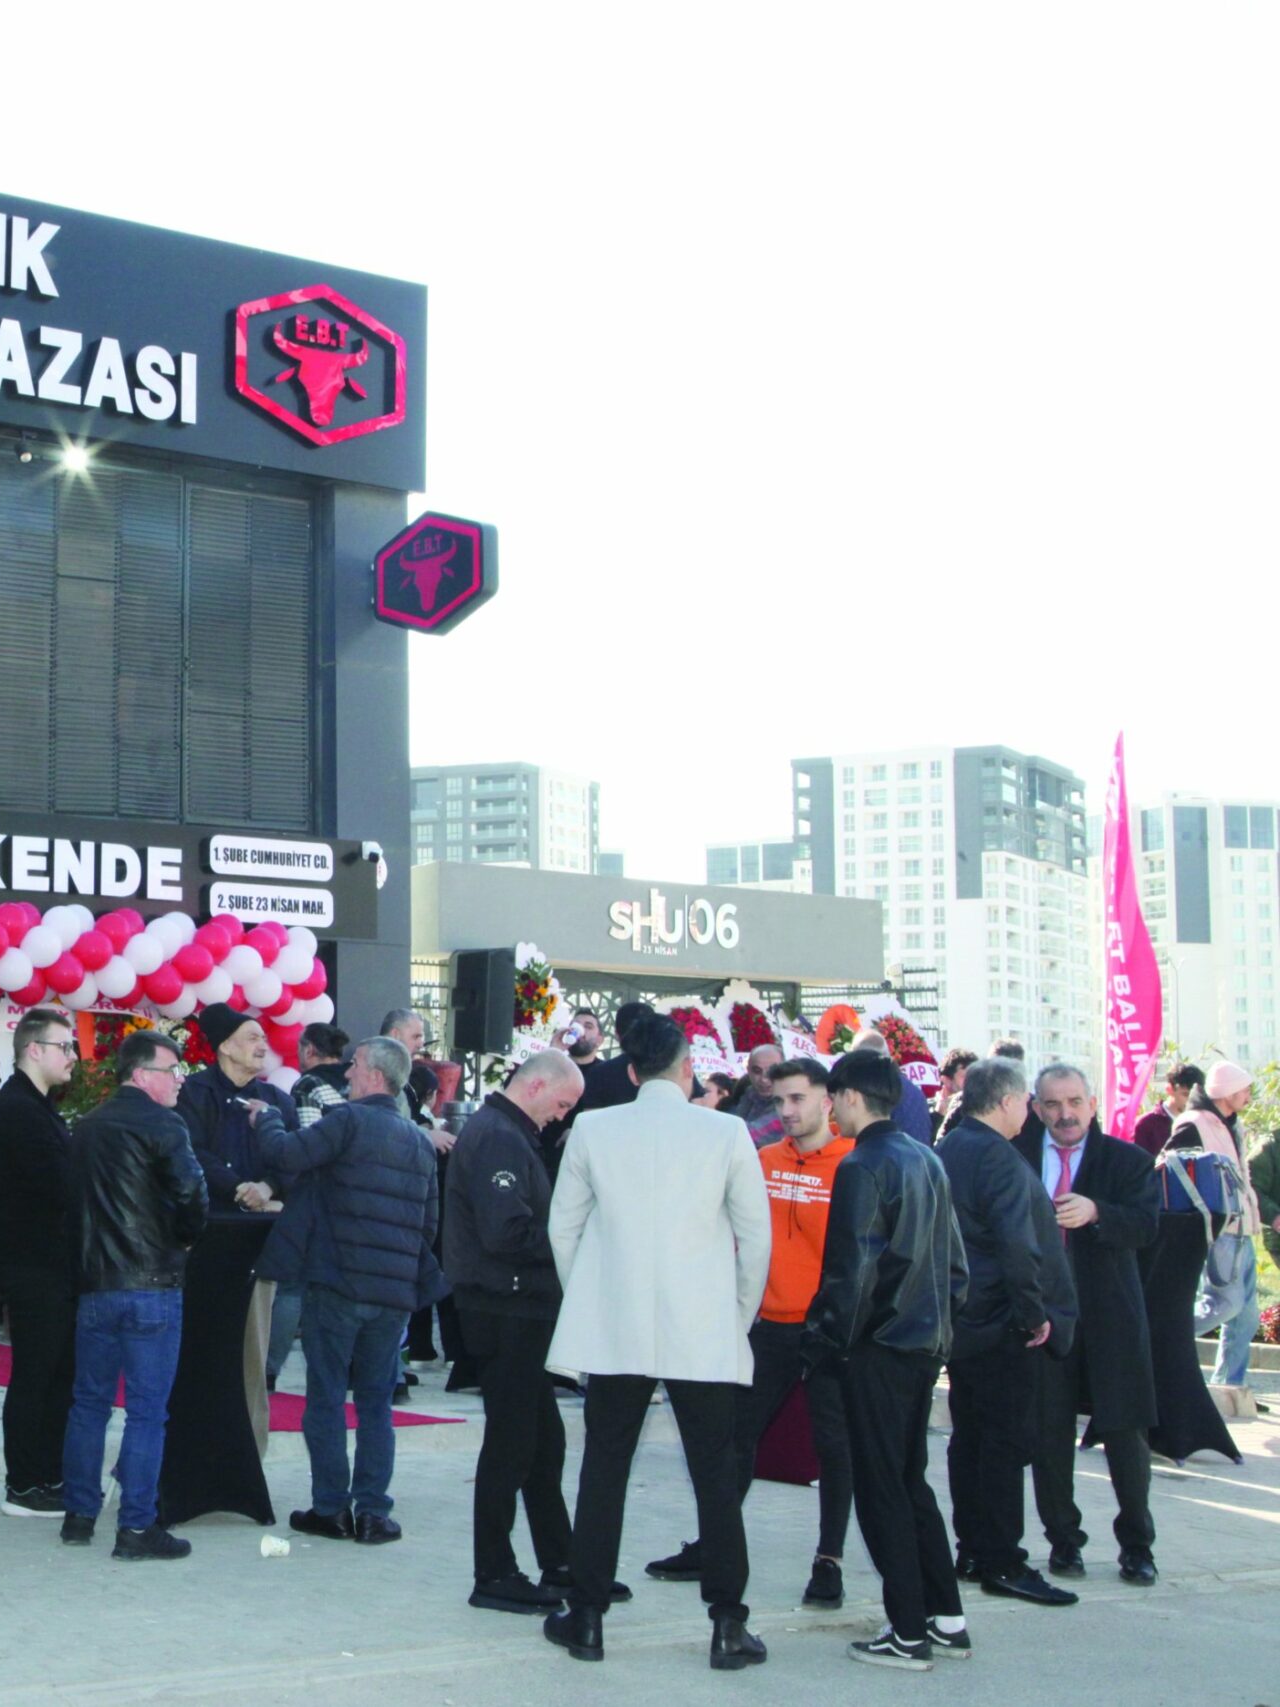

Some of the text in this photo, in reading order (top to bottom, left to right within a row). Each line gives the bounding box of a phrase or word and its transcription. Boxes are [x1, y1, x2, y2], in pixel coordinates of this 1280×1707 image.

[293, 314, 350, 350] E.B.T
[223, 847, 248, 865] ŞUBE
[250, 850, 312, 868] CUMHURİYET
[228, 895, 253, 911] ŞUBE
[256, 897, 268, 911] 23
[271, 896, 300, 913] NİSAN
[302, 900, 326, 915] MAH.
